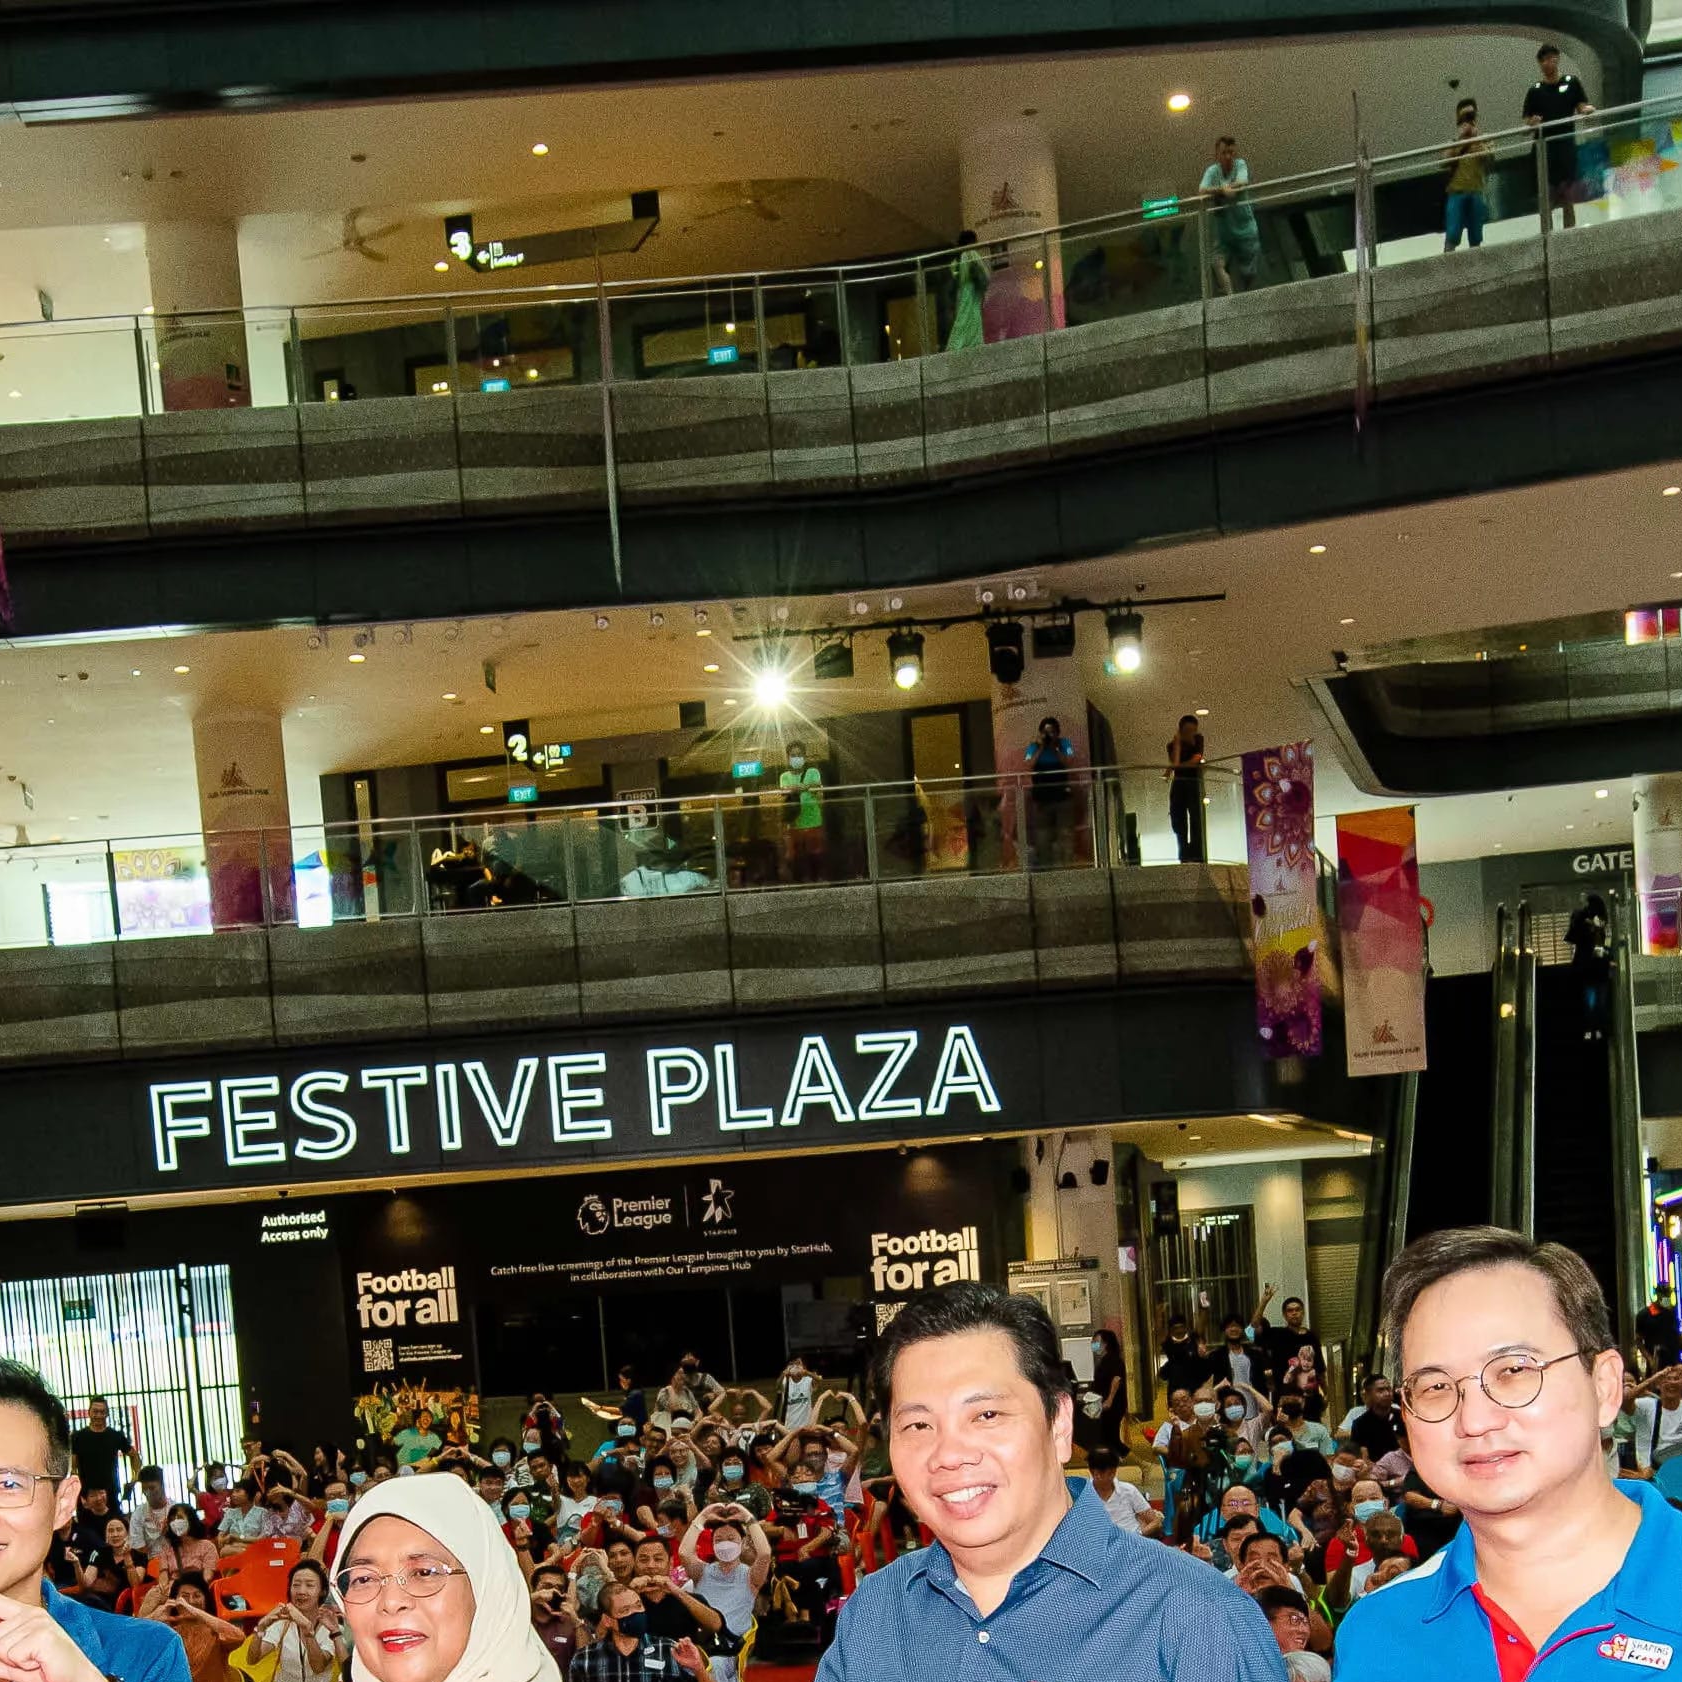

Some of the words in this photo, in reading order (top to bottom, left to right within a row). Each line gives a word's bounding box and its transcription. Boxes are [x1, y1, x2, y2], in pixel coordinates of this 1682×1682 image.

[450, 231, 471, 260] 3
[507, 734, 528, 762] 2
[739, 764, 757, 775] EXIT
[513, 790, 532, 801] EXIT
[628, 805, 649, 828] B
[1573, 850, 1634, 873] GATE
[149, 1052, 613, 1173] FESTIVE
[646, 1025, 1002, 1137] PLAZA
[613, 1195, 672, 1212] Premier
[261, 1210, 327, 1228] Authorised
[614, 1213, 672, 1230] League
[261, 1229, 300, 1243] Access
[302, 1226, 329, 1240] only
[870, 1226, 979, 1257] Football
[490, 1264, 517, 1276] Catch
[518, 1263, 538, 1274] free
[538, 1262, 554, 1273] live
[557, 1261, 604, 1272] screenings
[605, 1257, 616, 1267] of
[617, 1256, 632, 1266] the
[634, 1254, 670, 1264] Premier
[672, 1253, 705, 1264] League
[706, 1249, 743, 1261] brought
[745, 1249, 757, 1258] to
[758, 1248, 776, 1259] you
[777, 1246, 789, 1257] by
[790, 1242, 833, 1254] StarHub,
[870, 1256, 929, 1292] for
[933, 1249, 981, 1287] all
[356, 1266, 456, 1295] Football
[570, 1273, 580, 1283] in
[581, 1268, 643, 1282] collaboration
[643, 1266, 666, 1277] with
[666, 1266, 684, 1275] Our
[687, 1263, 730, 1275] Tampines
[732, 1261, 752, 1271] Hub
[356, 1294, 412, 1329] for
[415, 1288, 459, 1325] all
[1632, 1640, 1669, 1656] SHAPING
